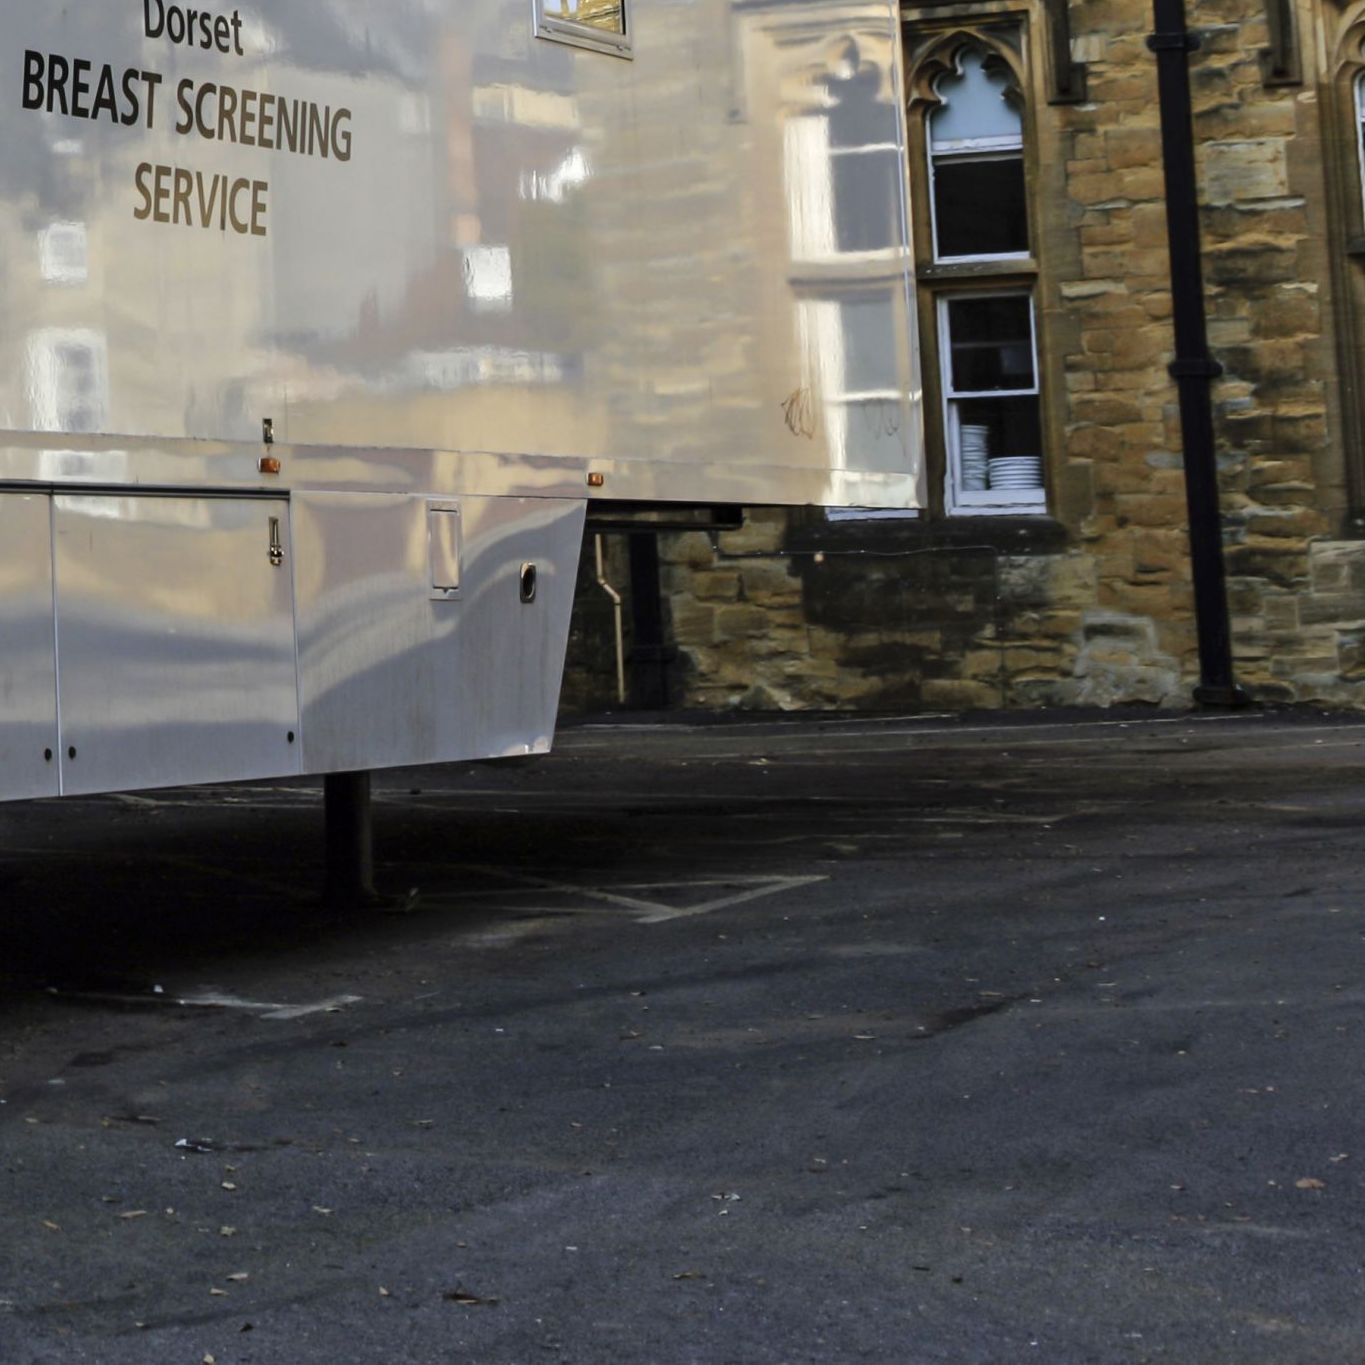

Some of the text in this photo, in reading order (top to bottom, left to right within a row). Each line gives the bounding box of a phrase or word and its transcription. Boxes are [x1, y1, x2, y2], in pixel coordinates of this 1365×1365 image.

[22, 50, 352, 162] BREAST SCREENING
[134, 162, 268, 236] SERVICE
